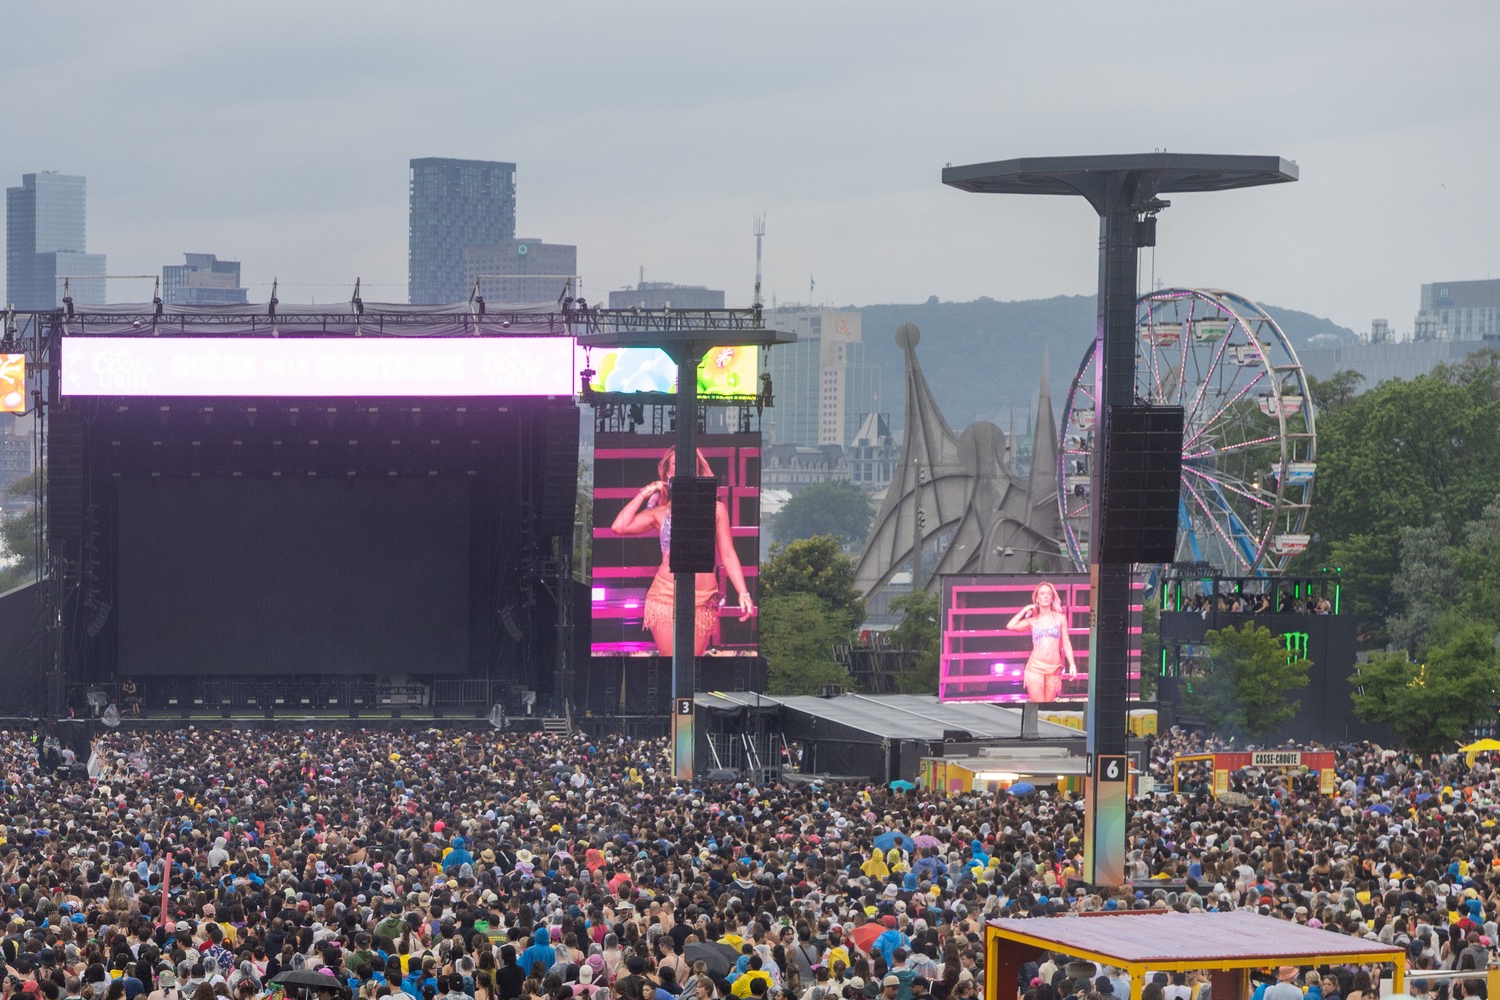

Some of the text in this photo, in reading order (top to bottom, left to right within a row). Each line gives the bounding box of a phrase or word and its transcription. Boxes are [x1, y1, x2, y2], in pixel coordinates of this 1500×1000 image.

[98, 373, 149, 387] LIGHT
[682, 701, 690, 713] 3
[1255, 753, 1297, 764] CASSE-CROÛTE
[1107, 760, 1119, 778] 6
